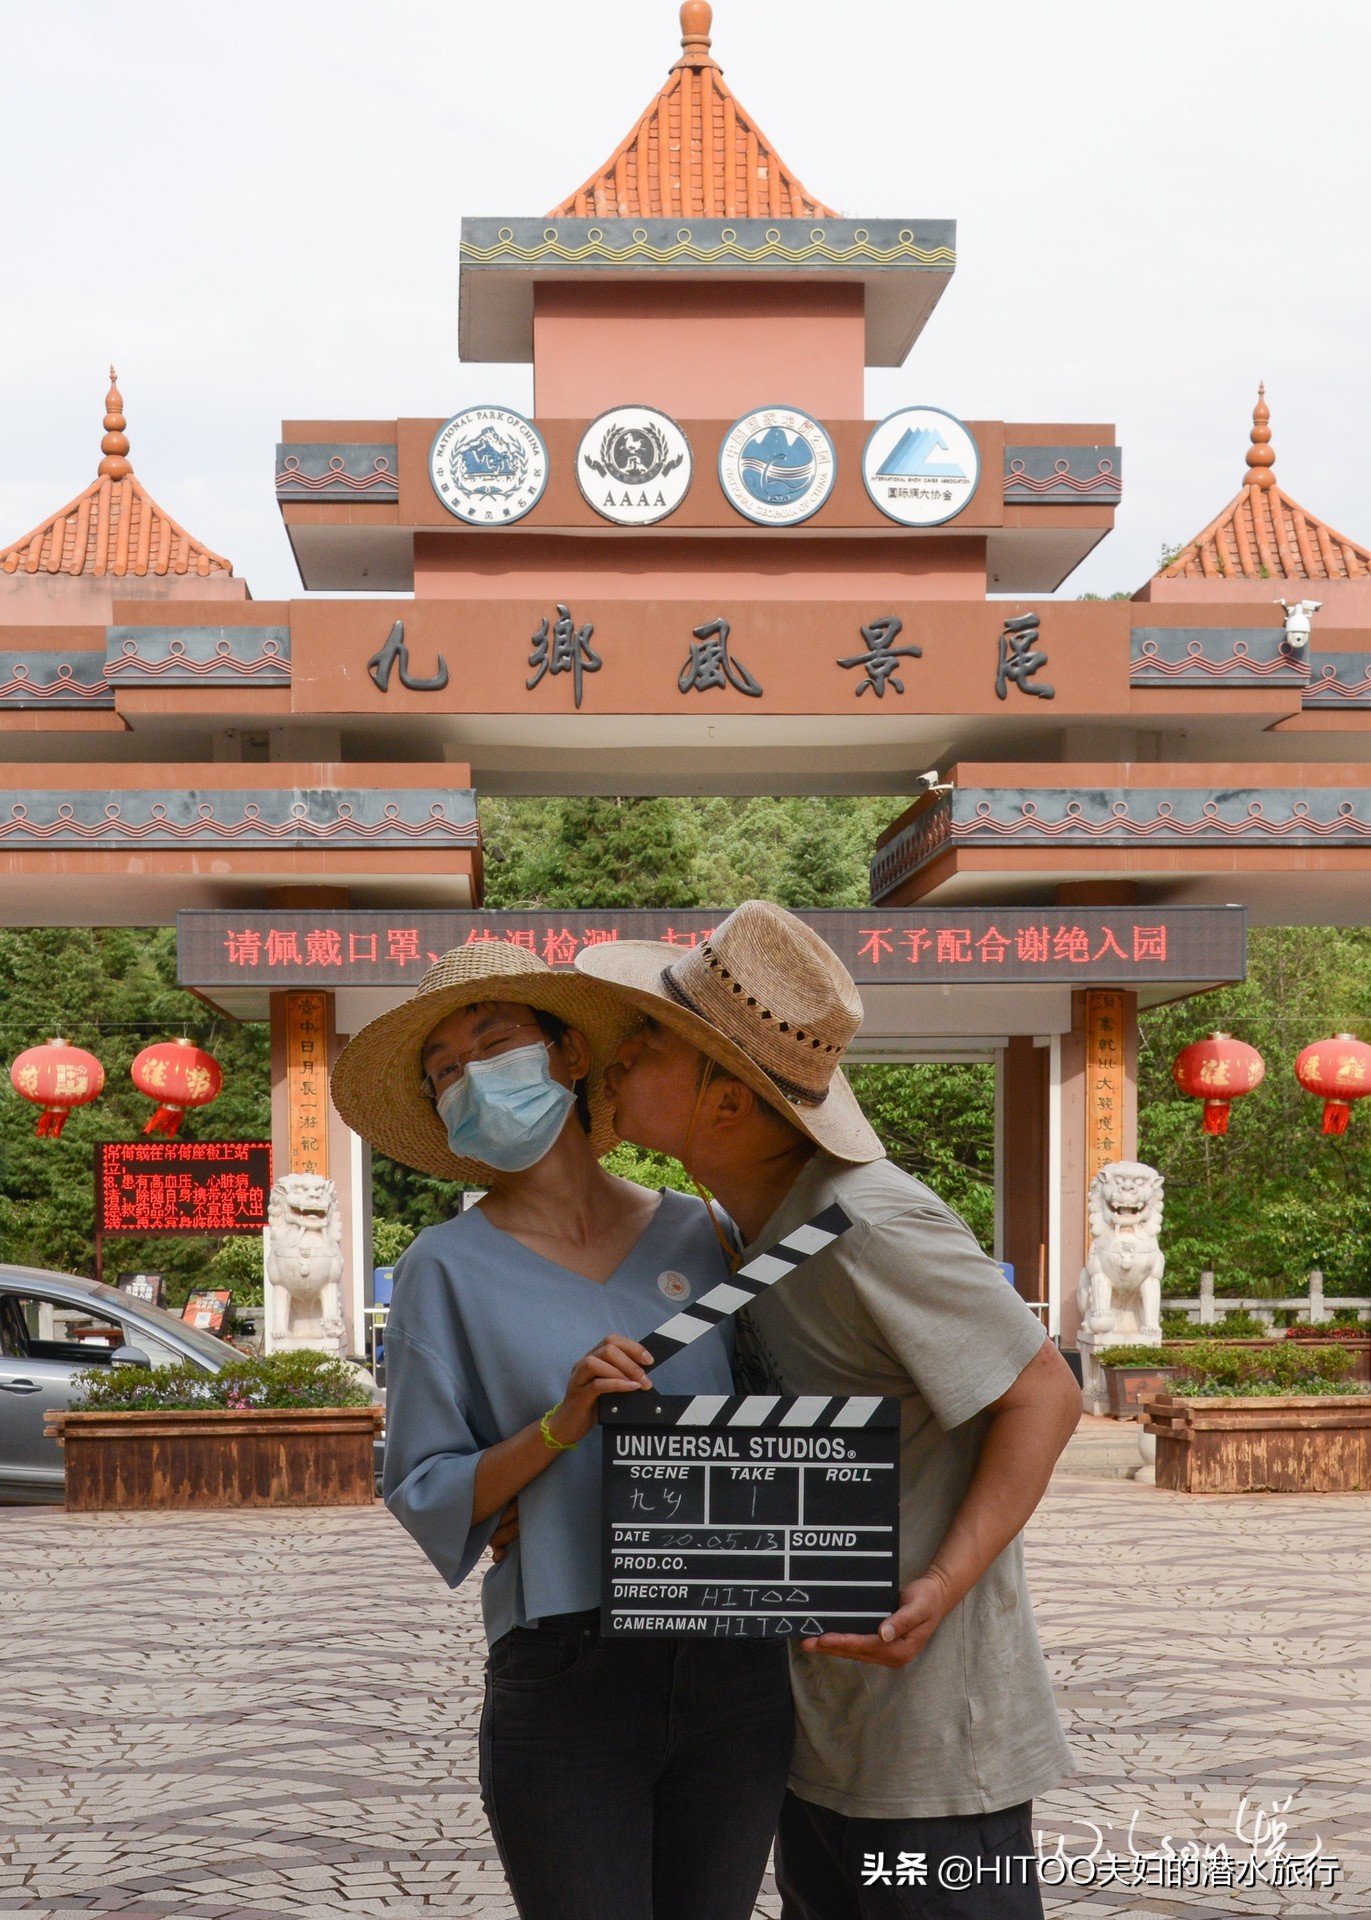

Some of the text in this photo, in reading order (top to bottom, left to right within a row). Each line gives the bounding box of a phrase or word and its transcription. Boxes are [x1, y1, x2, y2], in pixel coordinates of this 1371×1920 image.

[436, 411, 540, 457] NATIONAL PARK OF CHINA
[602, 490, 667, 507] AAAA
[857, 925, 1169, 963] 不予配合谢绝入园
[615, 1435, 740, 1458] UNIVERSAL
[630, 1466, 690, 1480] SCENE
[730, 1467, 776, 1481] TAKE
[825, 1468, 873, 1482] ROLL
[614, 1530, 651, 1542] DATE
[791, 1532, 857, 1547] SOUND
[614, 1556, 688, 1570] PROD.CO.
[613, 1585, 688, 1599] DIRECTOR
[613, 1617, 707, 1631] CAMERAMAN
